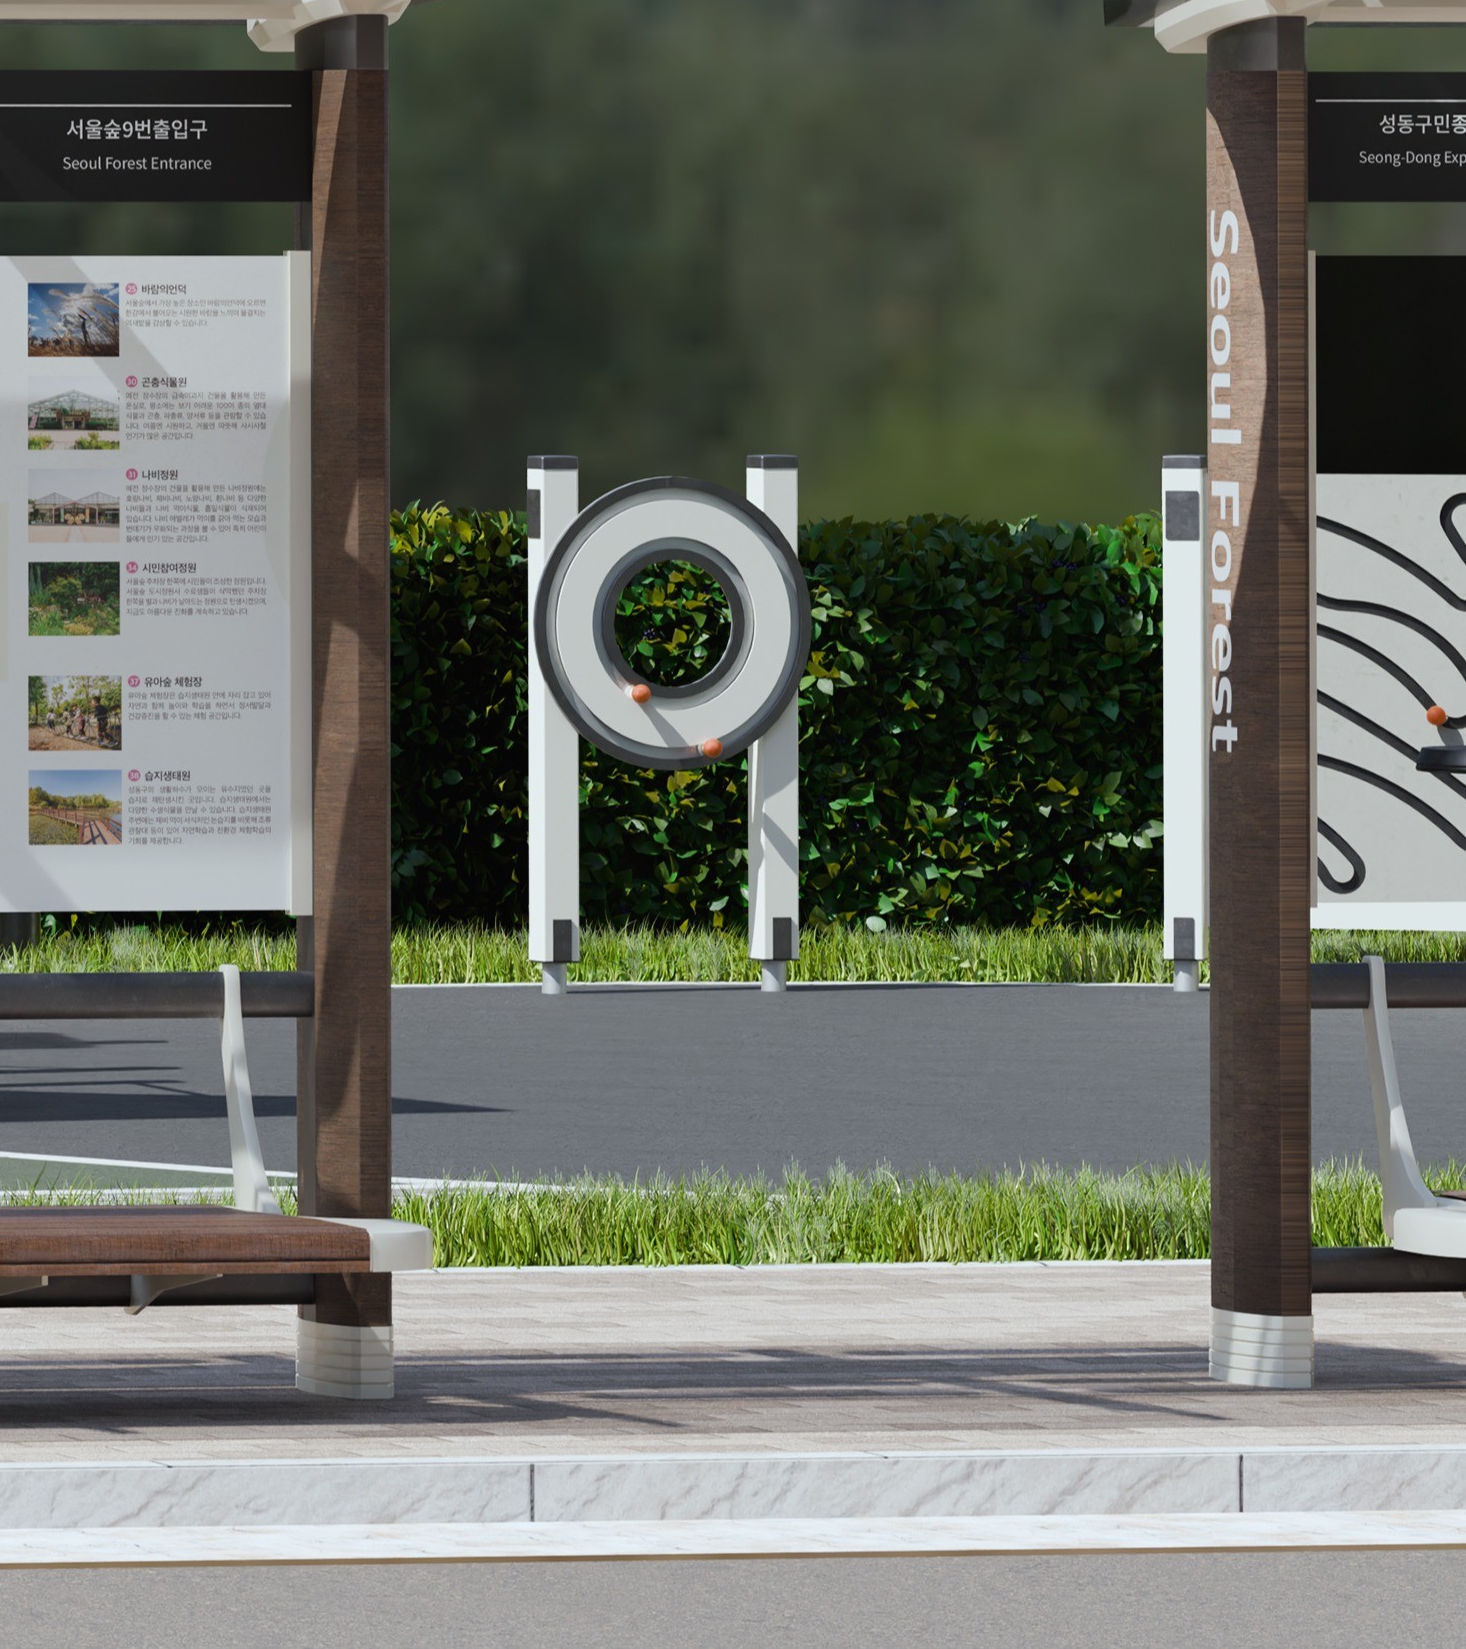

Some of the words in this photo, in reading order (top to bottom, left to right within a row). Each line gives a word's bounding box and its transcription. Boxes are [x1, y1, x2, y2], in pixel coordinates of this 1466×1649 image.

[67, 119, 207, 139] 서울숲9번출입구
[63, 156, 101, 169] Seoul
[106, 157, 147, 169] Forest
[152, 157, 211, 169] Entrance
[1360, 151, 1441, 167] Seong-Dong
[141, 284, 187, 295] 바람의언덕
[1210, 209, 1242, 445] Seoul
[141, 375, 187, 388] 곤충식물원
[141, 469, 179, 481] 나비정원
[142, 562, 197, 574] 시민참여정원
[1210, 480, 1240, 753] Forest
[144, 676, 172, 688] 유아숲
[174, 676, 203, 688] 체험장
[144, 770, 191, 782] 습지생태원
